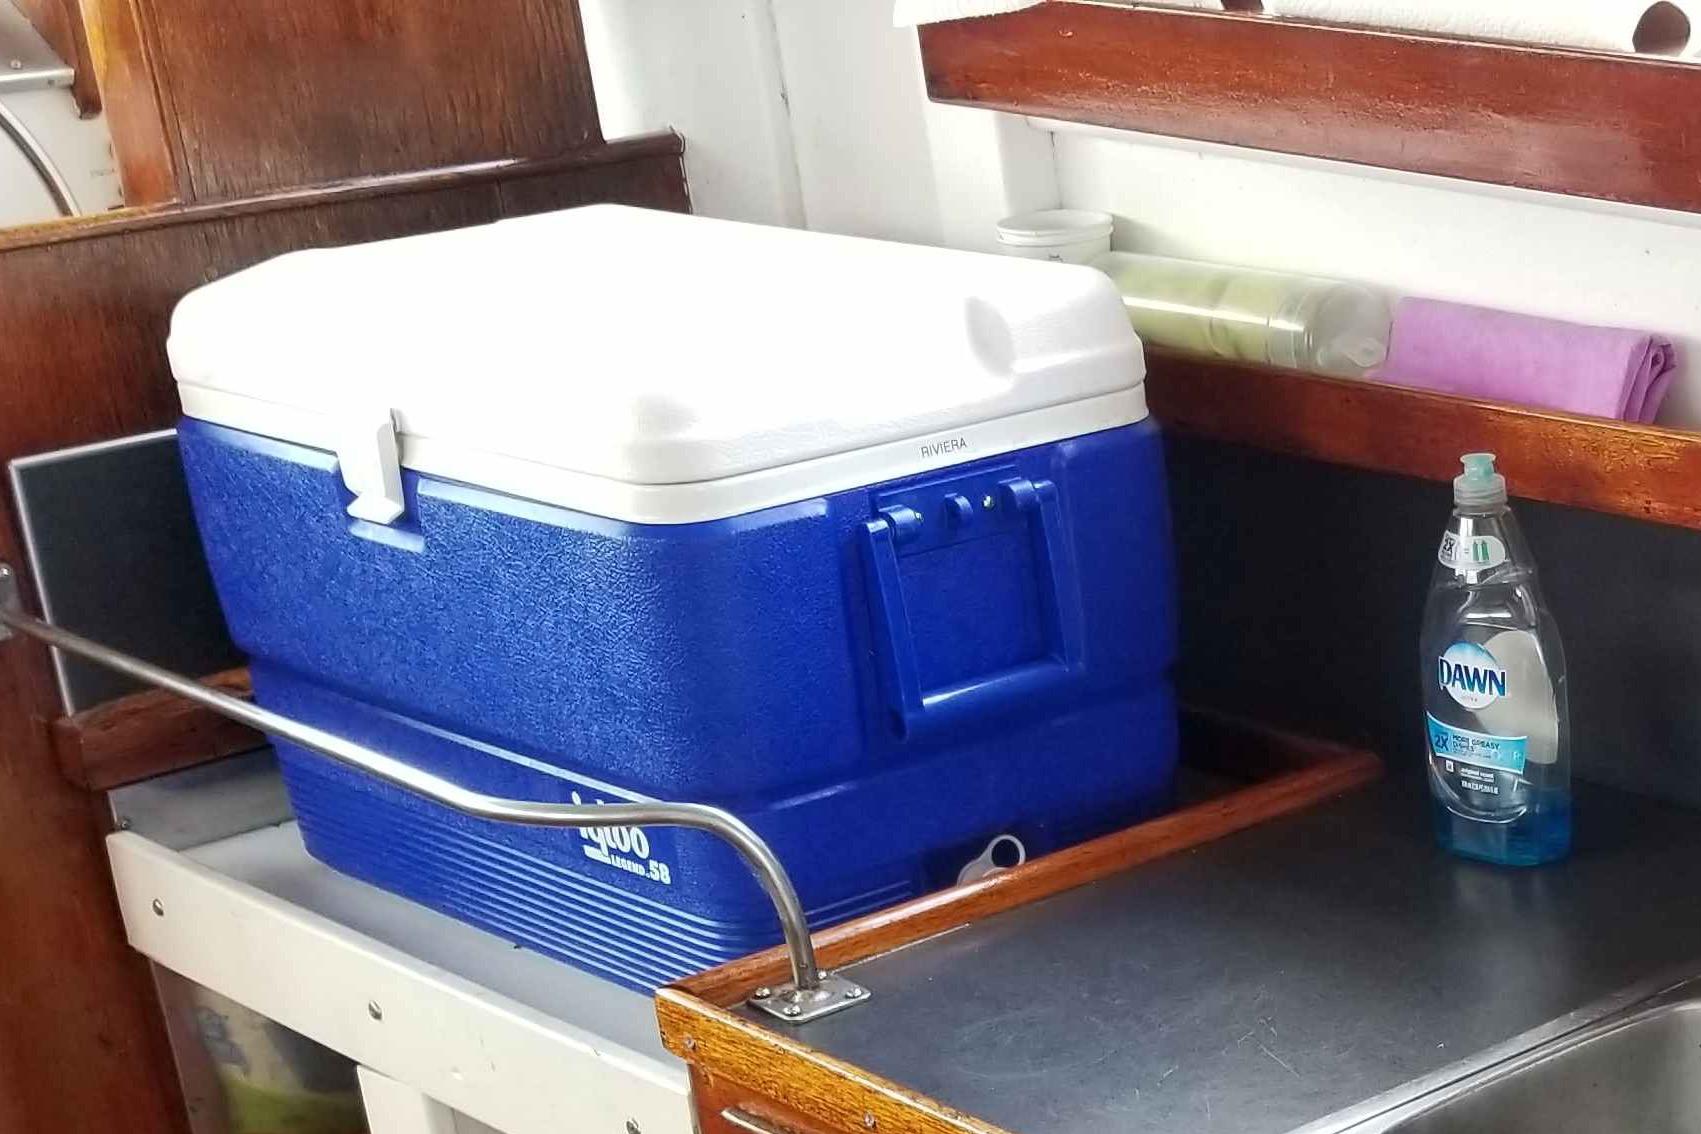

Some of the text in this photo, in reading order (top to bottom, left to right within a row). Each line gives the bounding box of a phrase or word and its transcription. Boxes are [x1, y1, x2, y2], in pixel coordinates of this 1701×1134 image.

[920, 437, 968, 458] RIVIERA
[1439, 658, 1506, 697] DAWN
[1434, 731, 1450, 751] 2X
